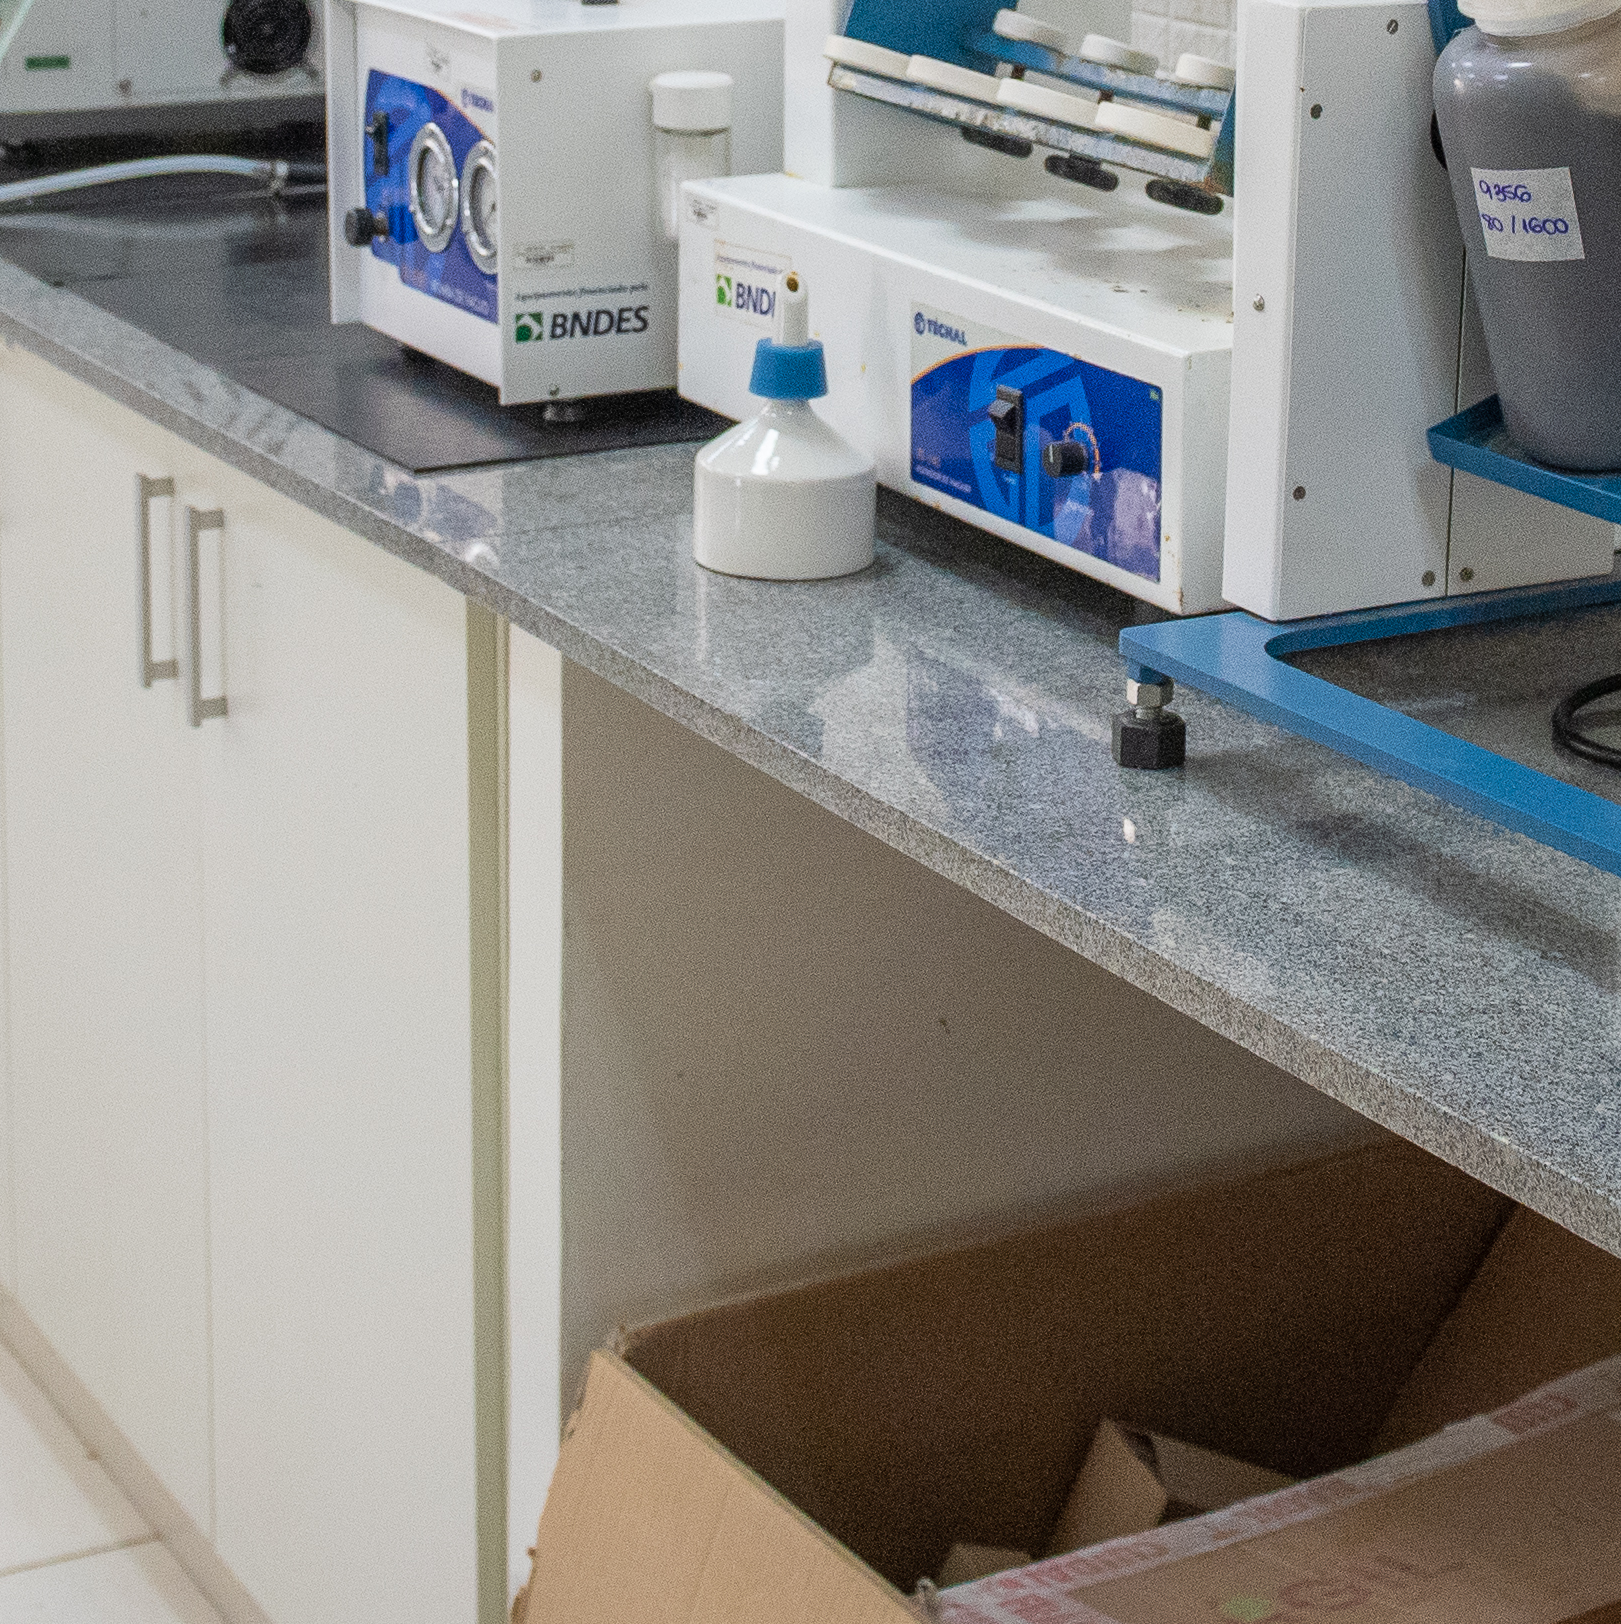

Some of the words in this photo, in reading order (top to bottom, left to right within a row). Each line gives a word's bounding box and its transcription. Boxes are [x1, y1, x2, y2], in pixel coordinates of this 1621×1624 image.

[1479, 180, 1531, 202] 9356
[1522, 216, 1569, 235] 1600
[735, 283, 776, 318] BND
[550, 304, 649, 340] BNDES
